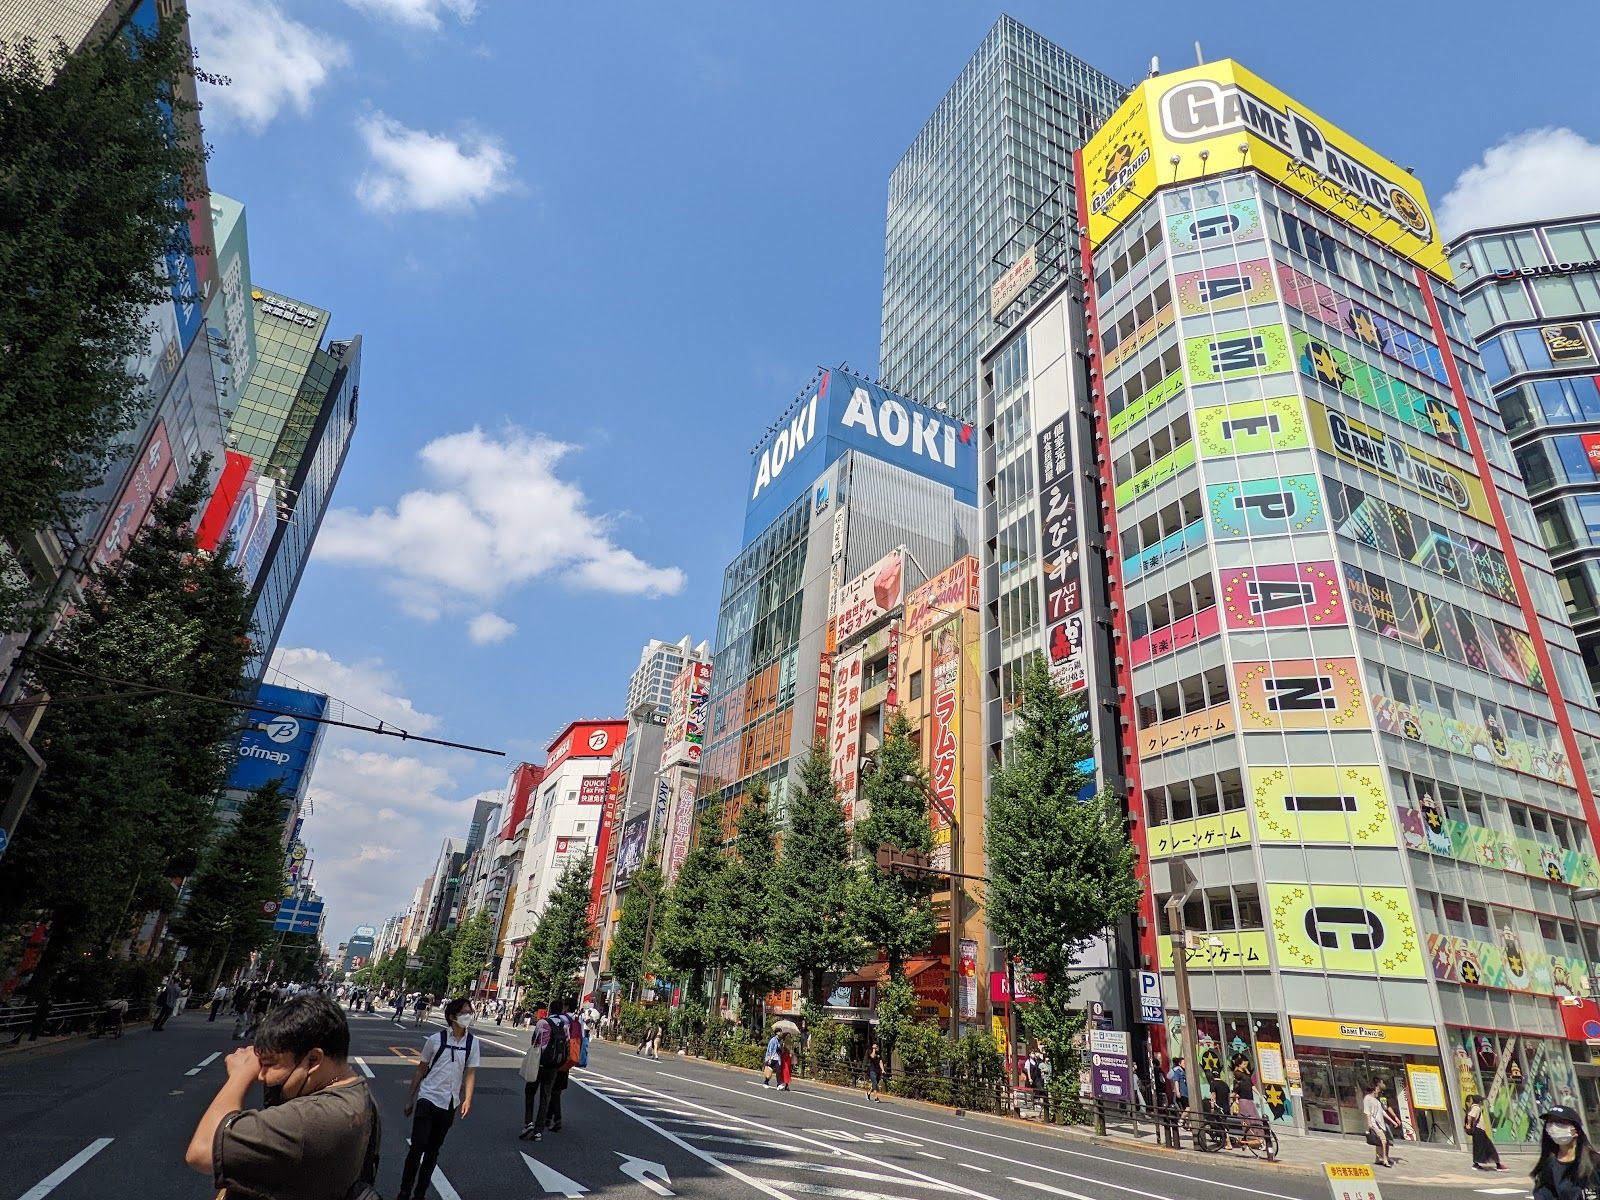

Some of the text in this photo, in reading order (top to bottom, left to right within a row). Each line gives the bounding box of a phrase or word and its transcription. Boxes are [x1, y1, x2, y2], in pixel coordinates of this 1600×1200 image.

[1166, 82, 1393, 210] GAME PANIC
[1093, 150, 1148, 212] GAME PANIC
[261, 303, 315, 328] 秋葉原ビル
[264, 295, 319, 321] 住友不動産
[1112, 380, 1184, 436] アーケードゲーム
[841, 386, 957, 469] AOKI
[752, 393, 818, 500] AOKI
[1330, 413, 1446, 493] GAME PANIC
[1131, 461, 1179, 495] 音楽ゲーム
[1139, 538, 1190, 572] 音楽ゲーム
[846, 570, 876, 598] ハニトー
[1347, 577, 1394, 604] MUSIC
[1049, 585, 1074, 618] 7F
[1351, 597, 1395, 625] GAME
[837, 607, 874, 641] カラオケ
[1147, 628, 1202, 656] 音楽ゲーム
[700, 667, 712, 679] 免
[1148, 719, 1226, 751] クレーンゲーム
[238, 743, 291, 765] ofmap
[583, 786, 605, 794] Tax Fre
[656, 780, 669, 815] AKKY
[1158, 825, 1242, 853] クレーンゲーム
[1142, 974, 1156, 994] P
[1142, 1006, 1154, 1018] IN
[1340, 1025, 1378, 1037] GAME PANIC
